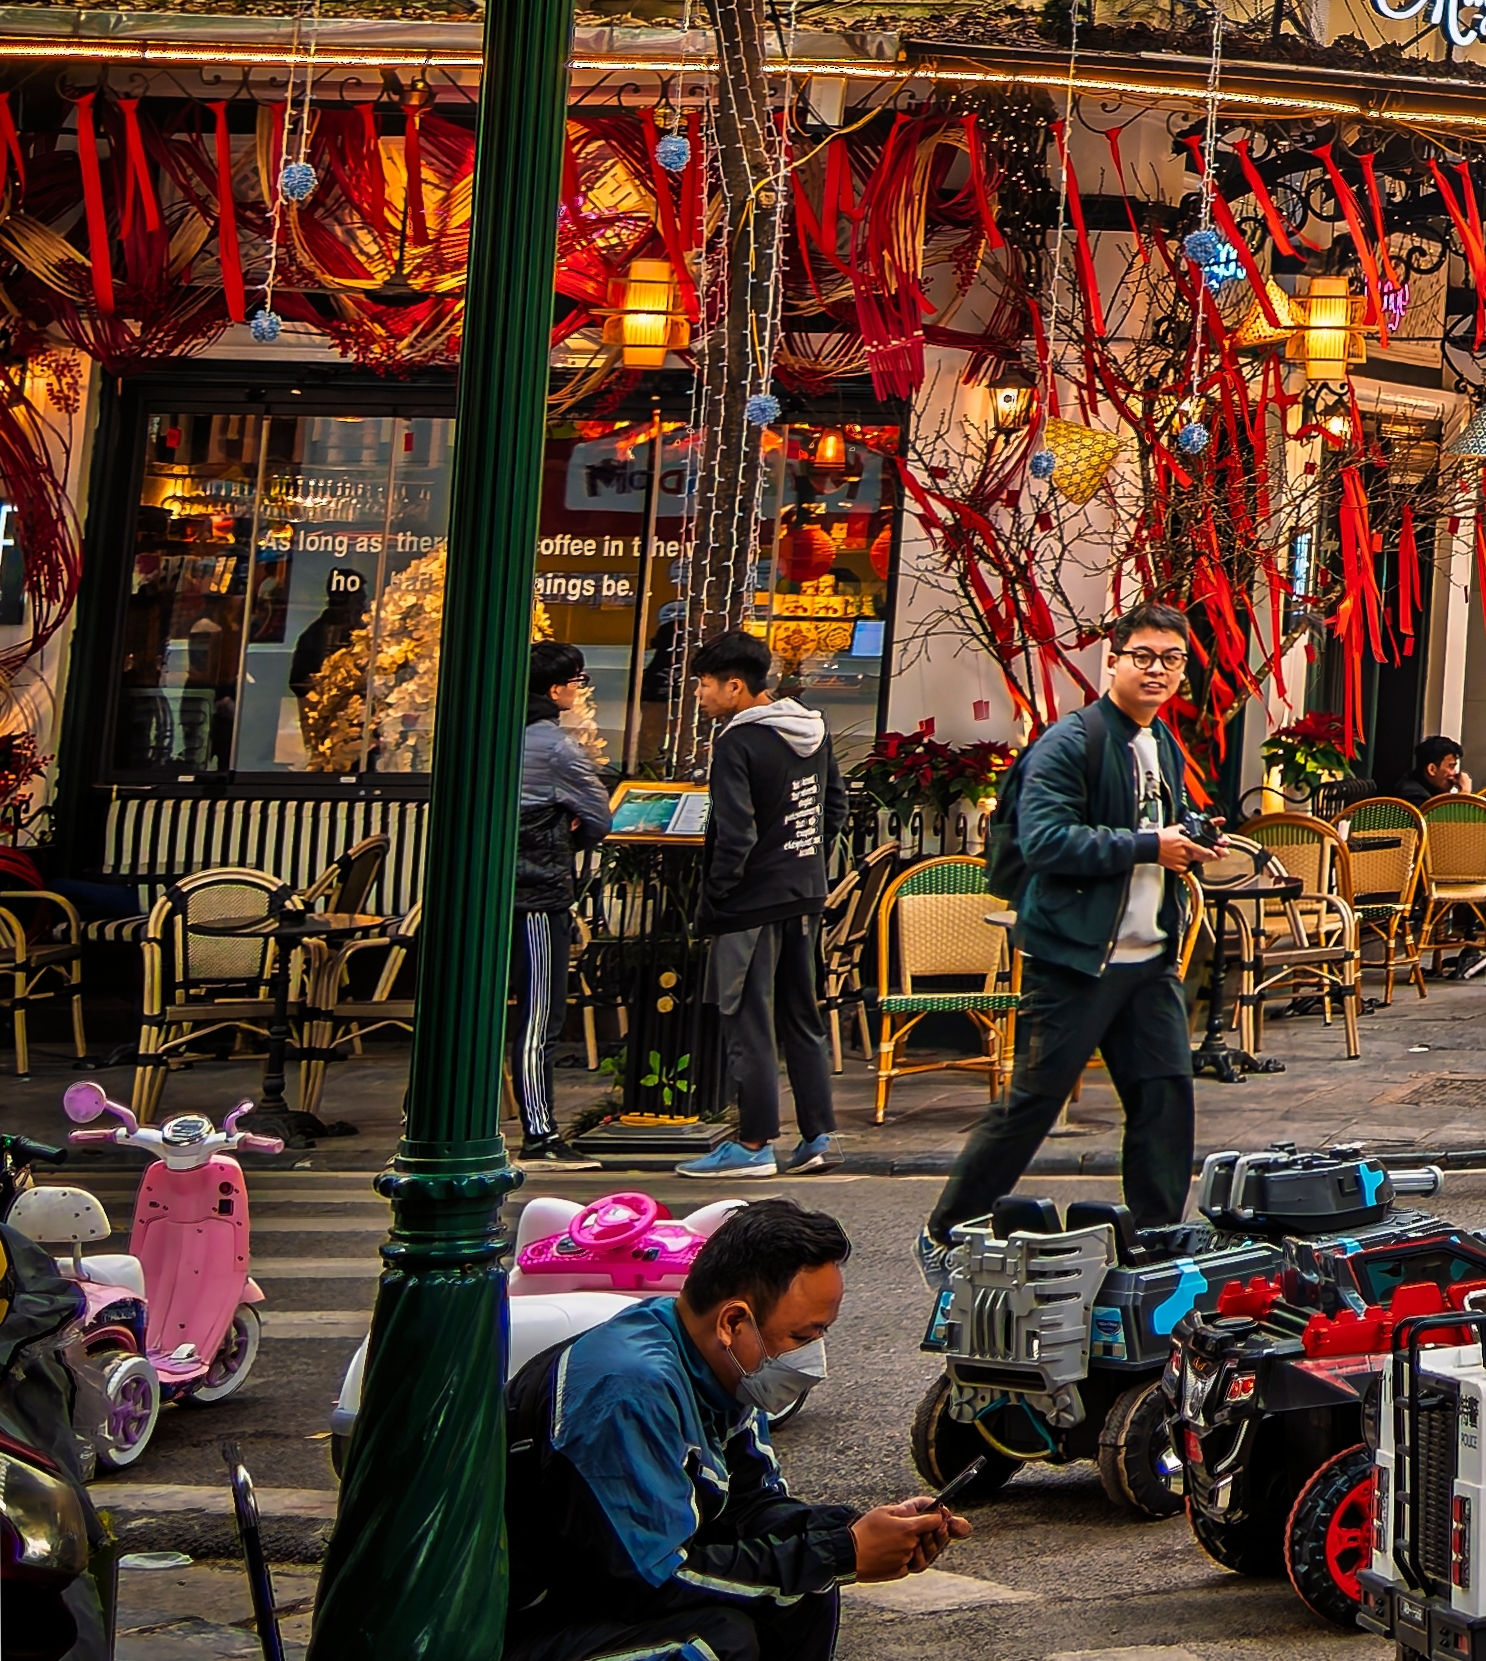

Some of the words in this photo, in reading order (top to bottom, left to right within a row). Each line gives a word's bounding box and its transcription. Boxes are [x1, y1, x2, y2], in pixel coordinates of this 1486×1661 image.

[298, 530, 349, 557] long
[356, 536, 383, 553] as
[396, 531, 448, 553] ther
[536, 534, 597, 557] offee
[603, 535, 624, 557] in
